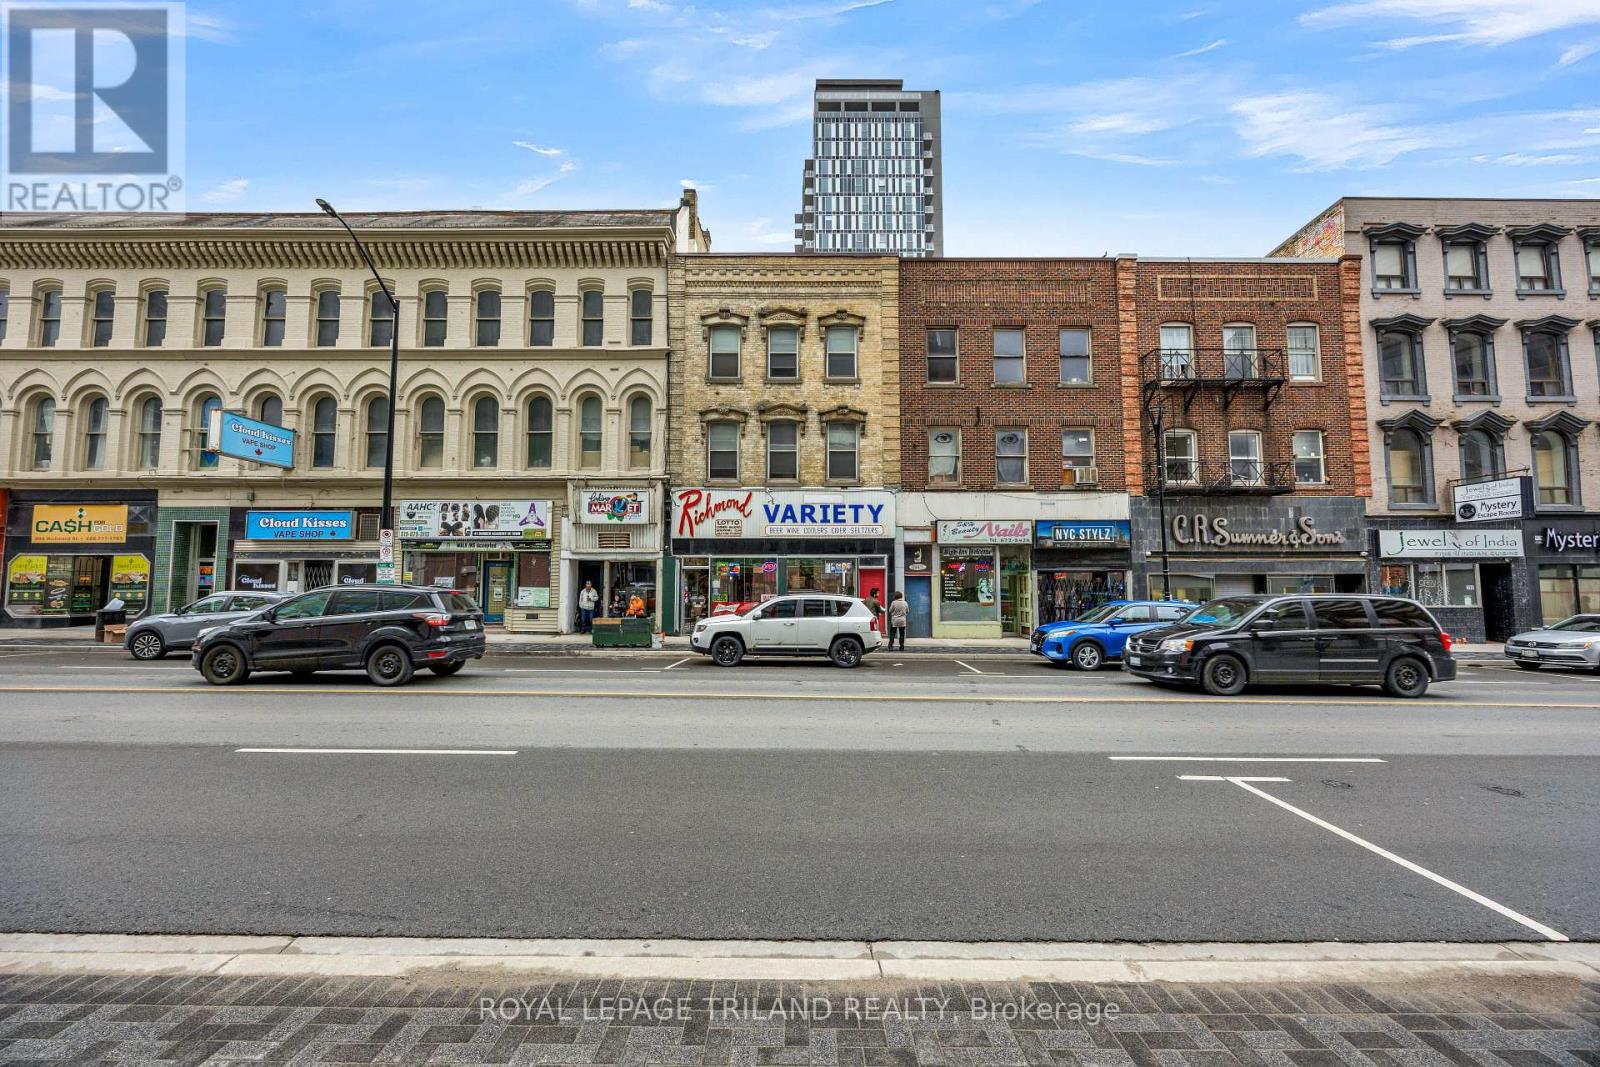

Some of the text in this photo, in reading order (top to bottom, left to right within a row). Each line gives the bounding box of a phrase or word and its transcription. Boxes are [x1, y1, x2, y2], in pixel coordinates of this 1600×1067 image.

[231, 423, 292, 445] Cloud Kisses
[242, 438, 277, 450] VAPE SHOP
[591, 498, 640, 514] MARKET
[678, 489, 753, 537] Richmond
[1480, 501, 1517, 512] Mystery
[763, 504, 884, 523] VARIETY
[259, 517, 347, 528] Cloud Kisses
[963, 521, 1030, 538] Nails
[273, 530, 324, 538] VAPE SHOP
[951, 526, 980, 535] Beauty
[1056, 528, 1111, 541] NYC STYLZ
[1386, 531, 1517, 556] Jewel of India
